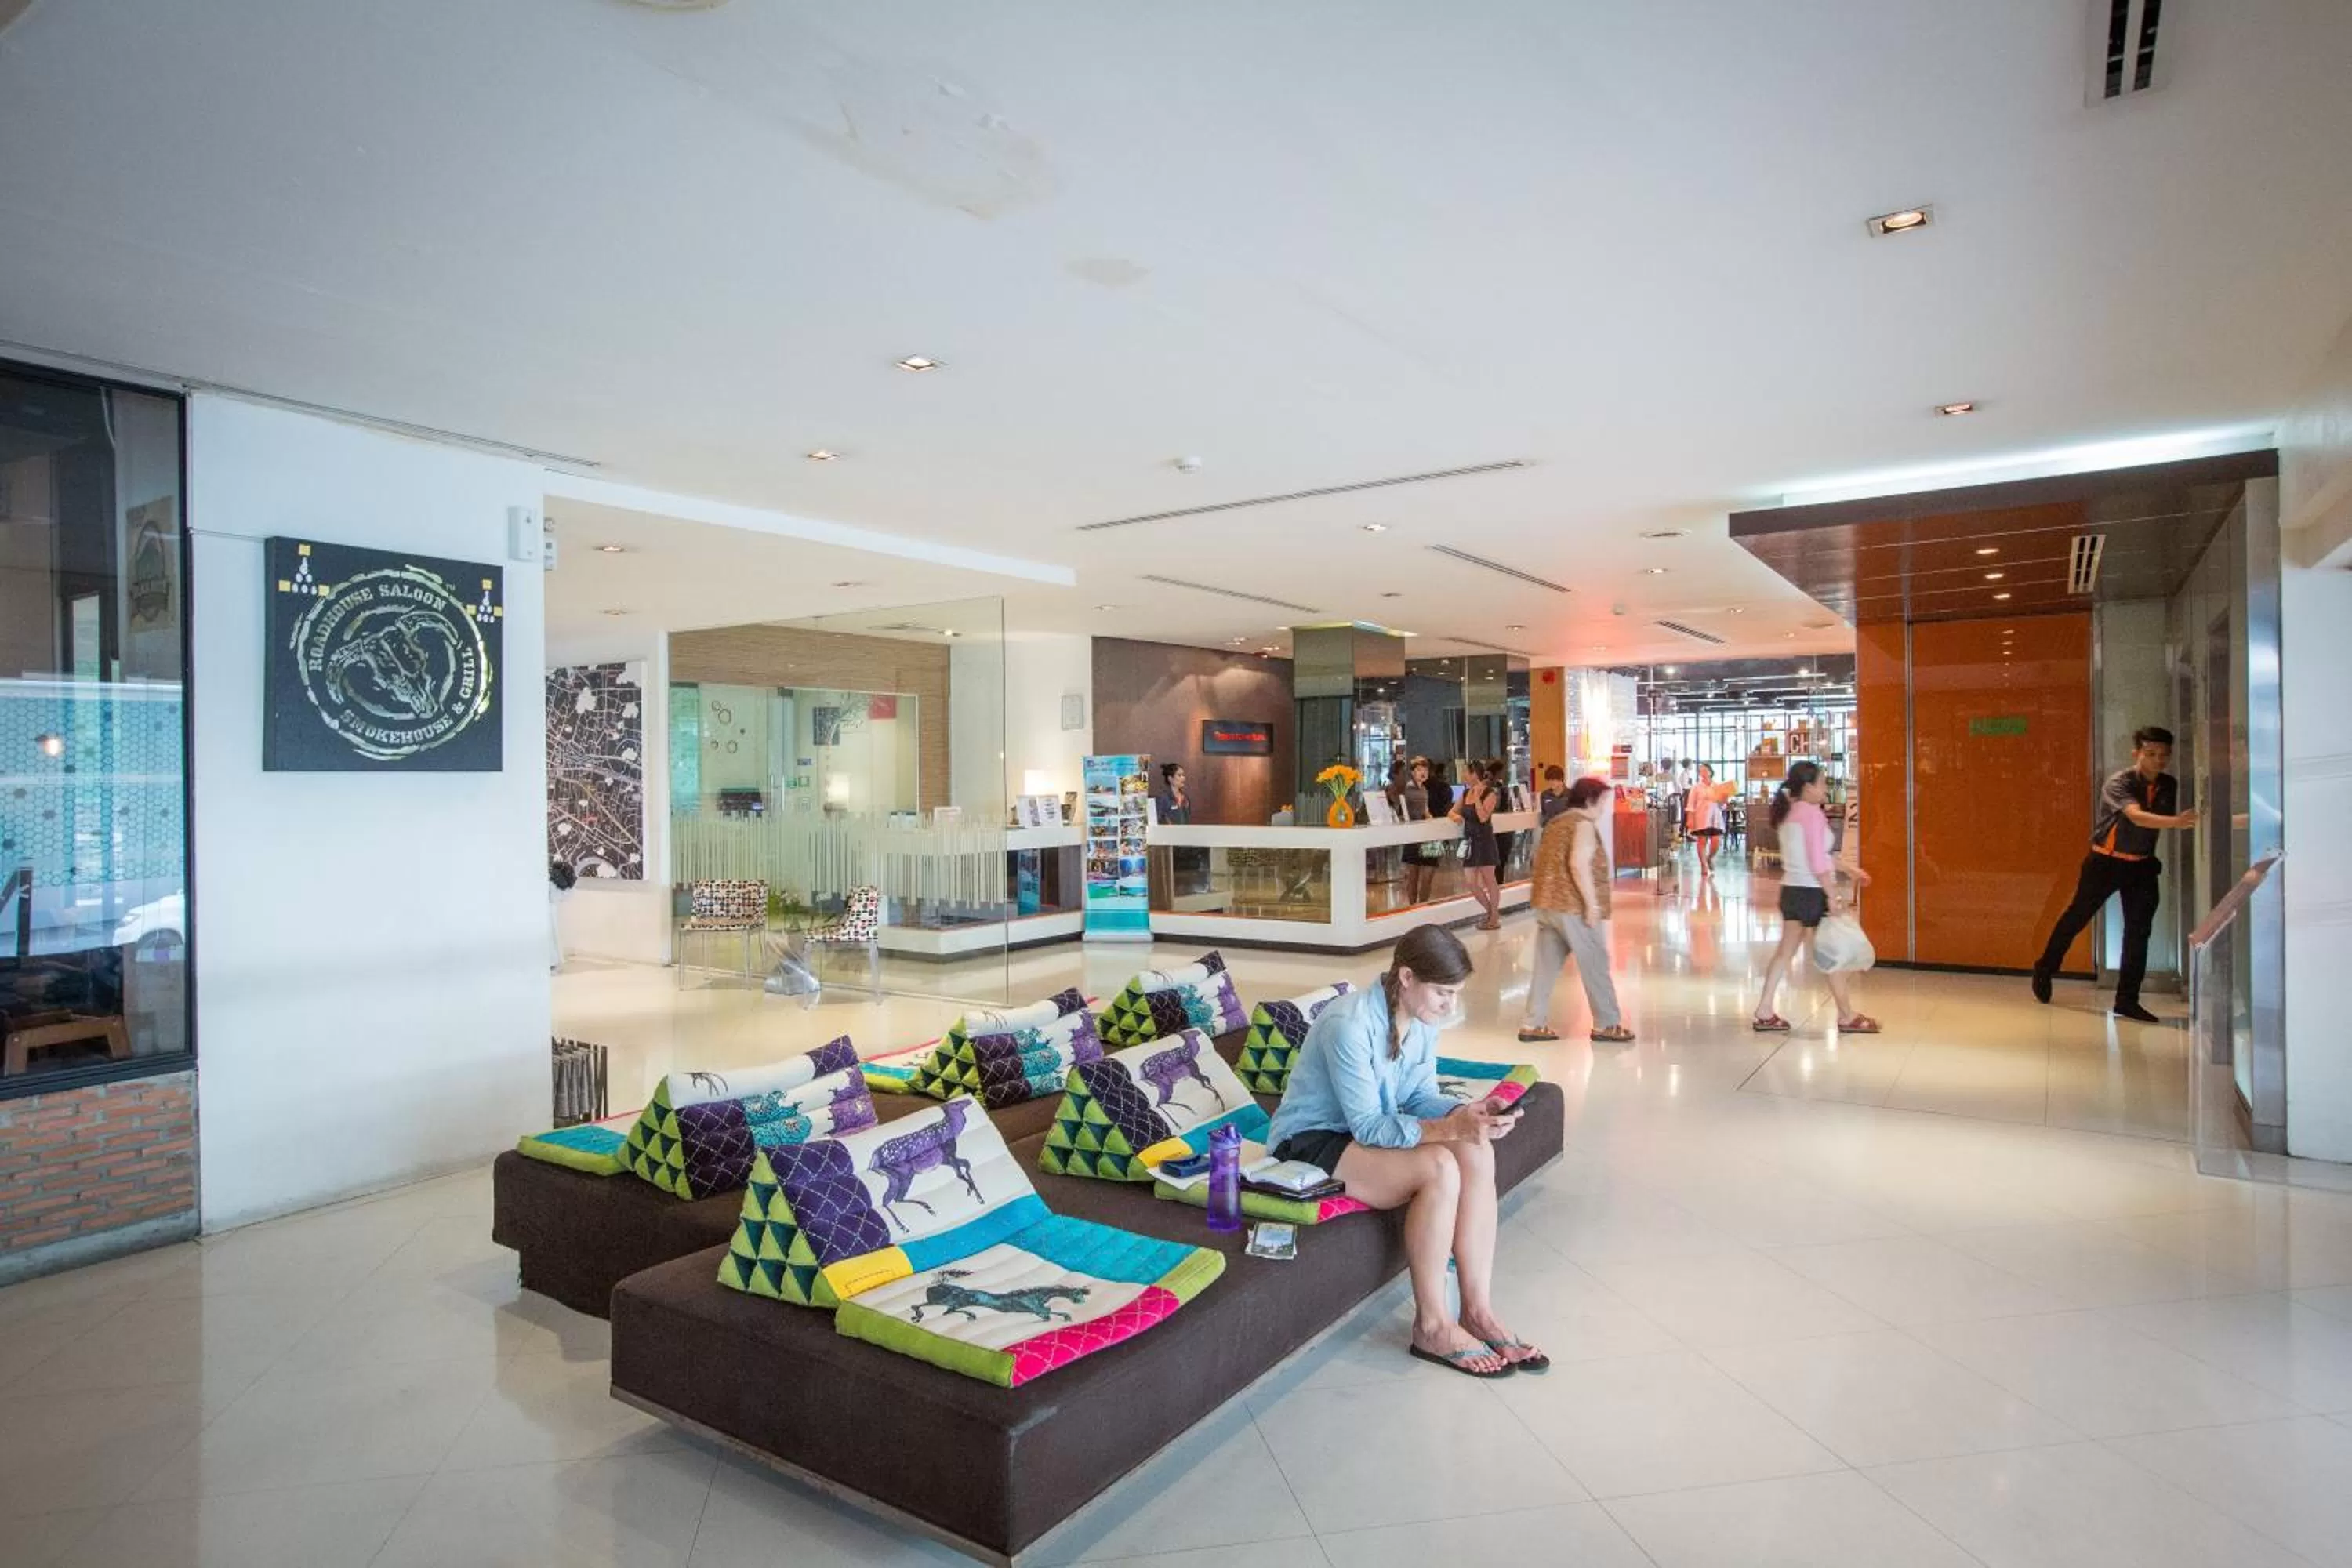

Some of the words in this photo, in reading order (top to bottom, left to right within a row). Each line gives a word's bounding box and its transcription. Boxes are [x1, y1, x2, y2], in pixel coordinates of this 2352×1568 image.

[308, 585, 374, 672] ROADHOUSE
[378, 583, 447, 612] SALOON
[339, 708, 455, 746] SMOKEHOUSE
[451, 701, 465, 715] &
[459, 647, 476, 699] GRILL
